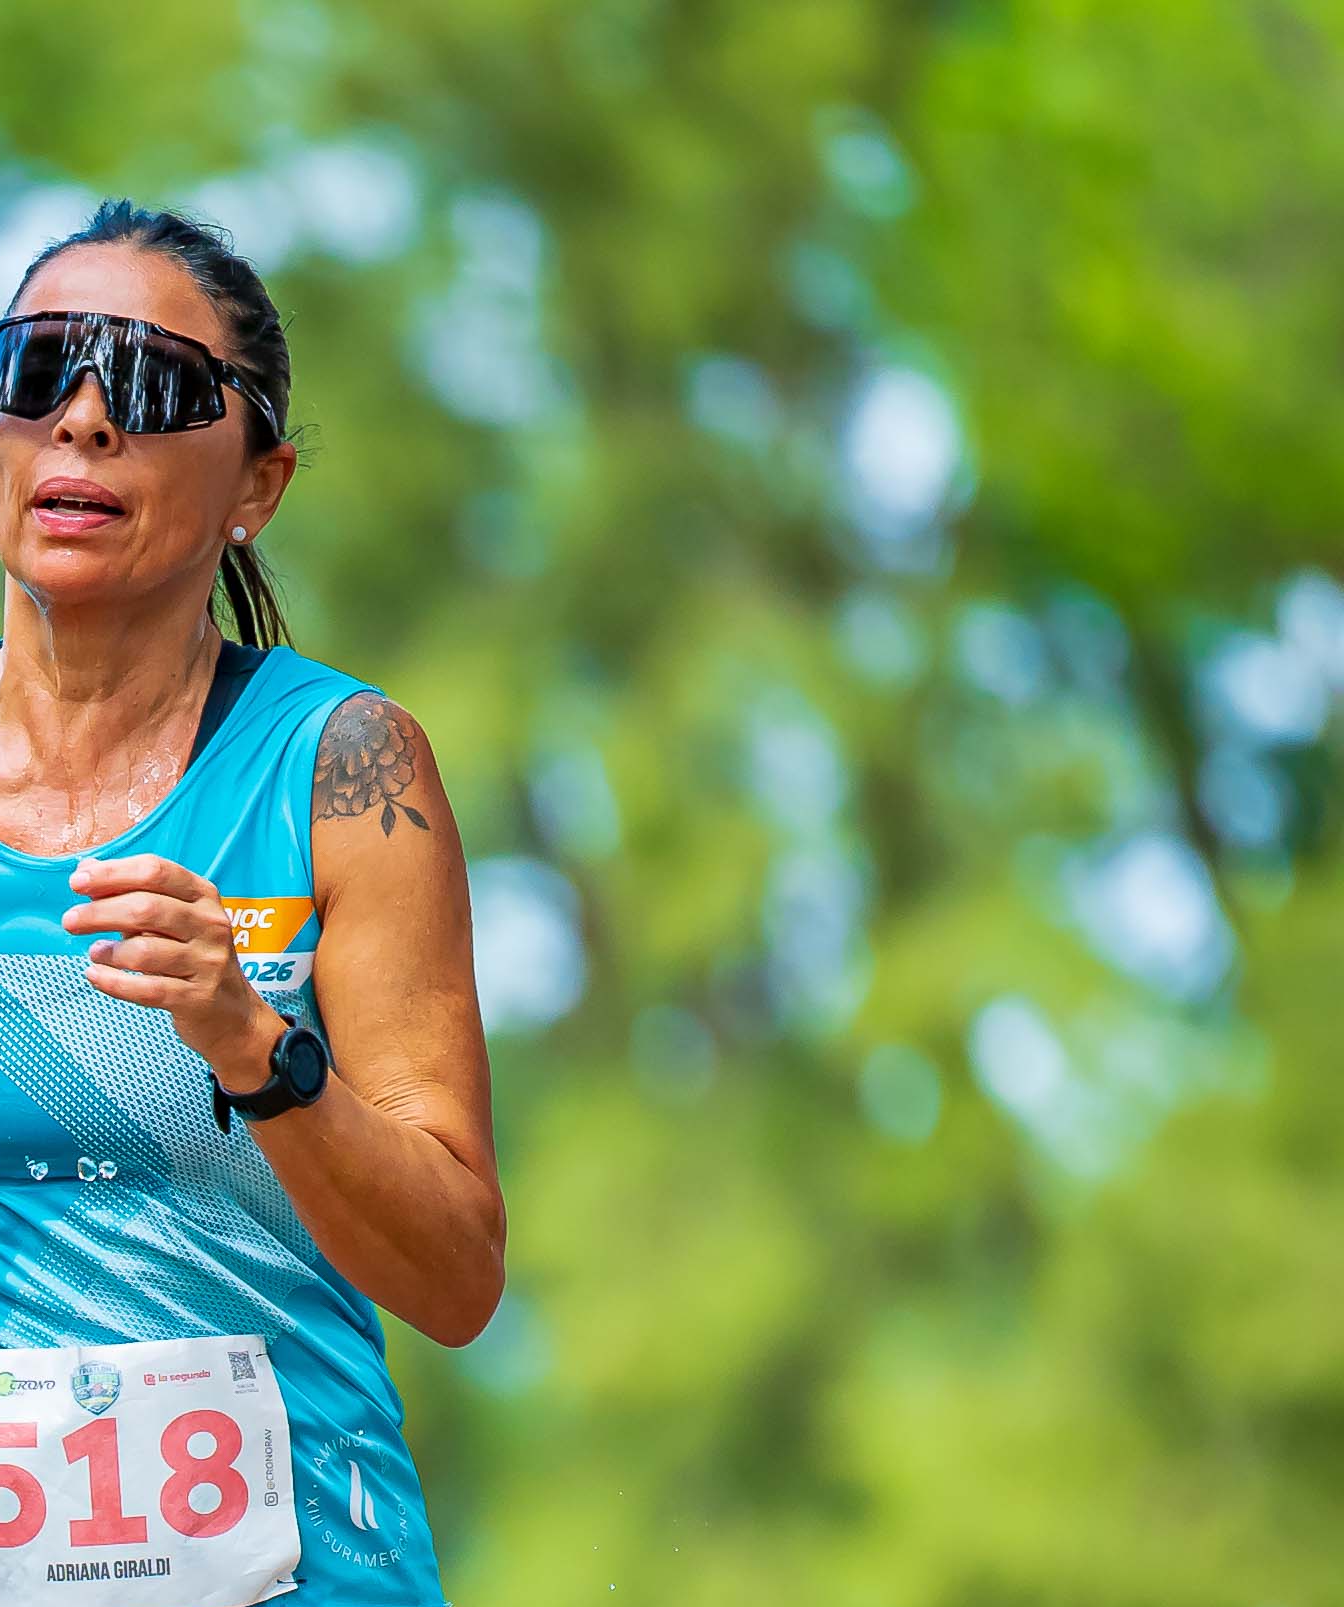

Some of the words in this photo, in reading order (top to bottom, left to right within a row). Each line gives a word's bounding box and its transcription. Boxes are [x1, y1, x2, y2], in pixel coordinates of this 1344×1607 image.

[241, 961, 296, 982] 026
[170, 1370, 211, 1382] segunda
[46, 1561, 111, 1582] ADRIANA
[113, 1557, 171, 1580] GIRALDI
